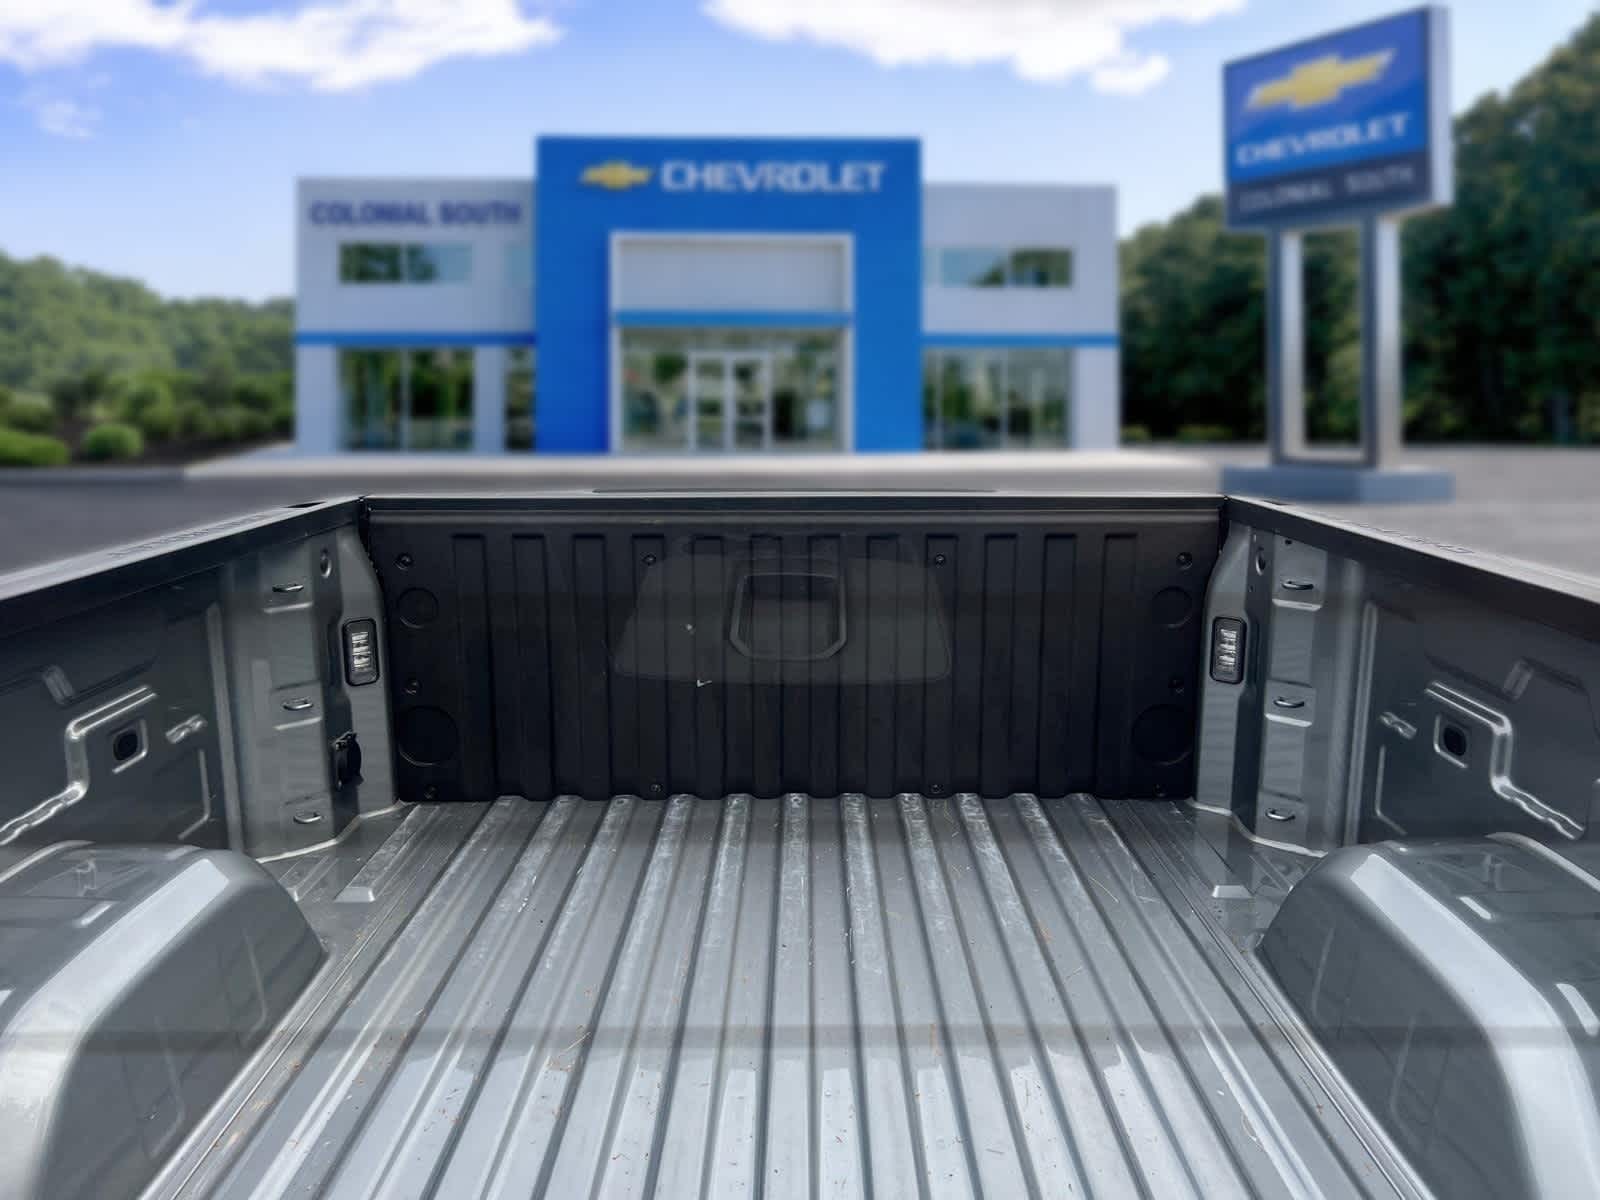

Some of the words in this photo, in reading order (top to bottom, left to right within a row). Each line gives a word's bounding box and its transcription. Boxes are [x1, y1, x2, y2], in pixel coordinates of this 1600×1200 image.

[1236, 112, 1409, 165] CHEVROLET
[661, 160, 886, 193] CHEVROLET
[310, 202, 432, 226] COLONIAL
[440, 201, 522, 226] SOUTH
